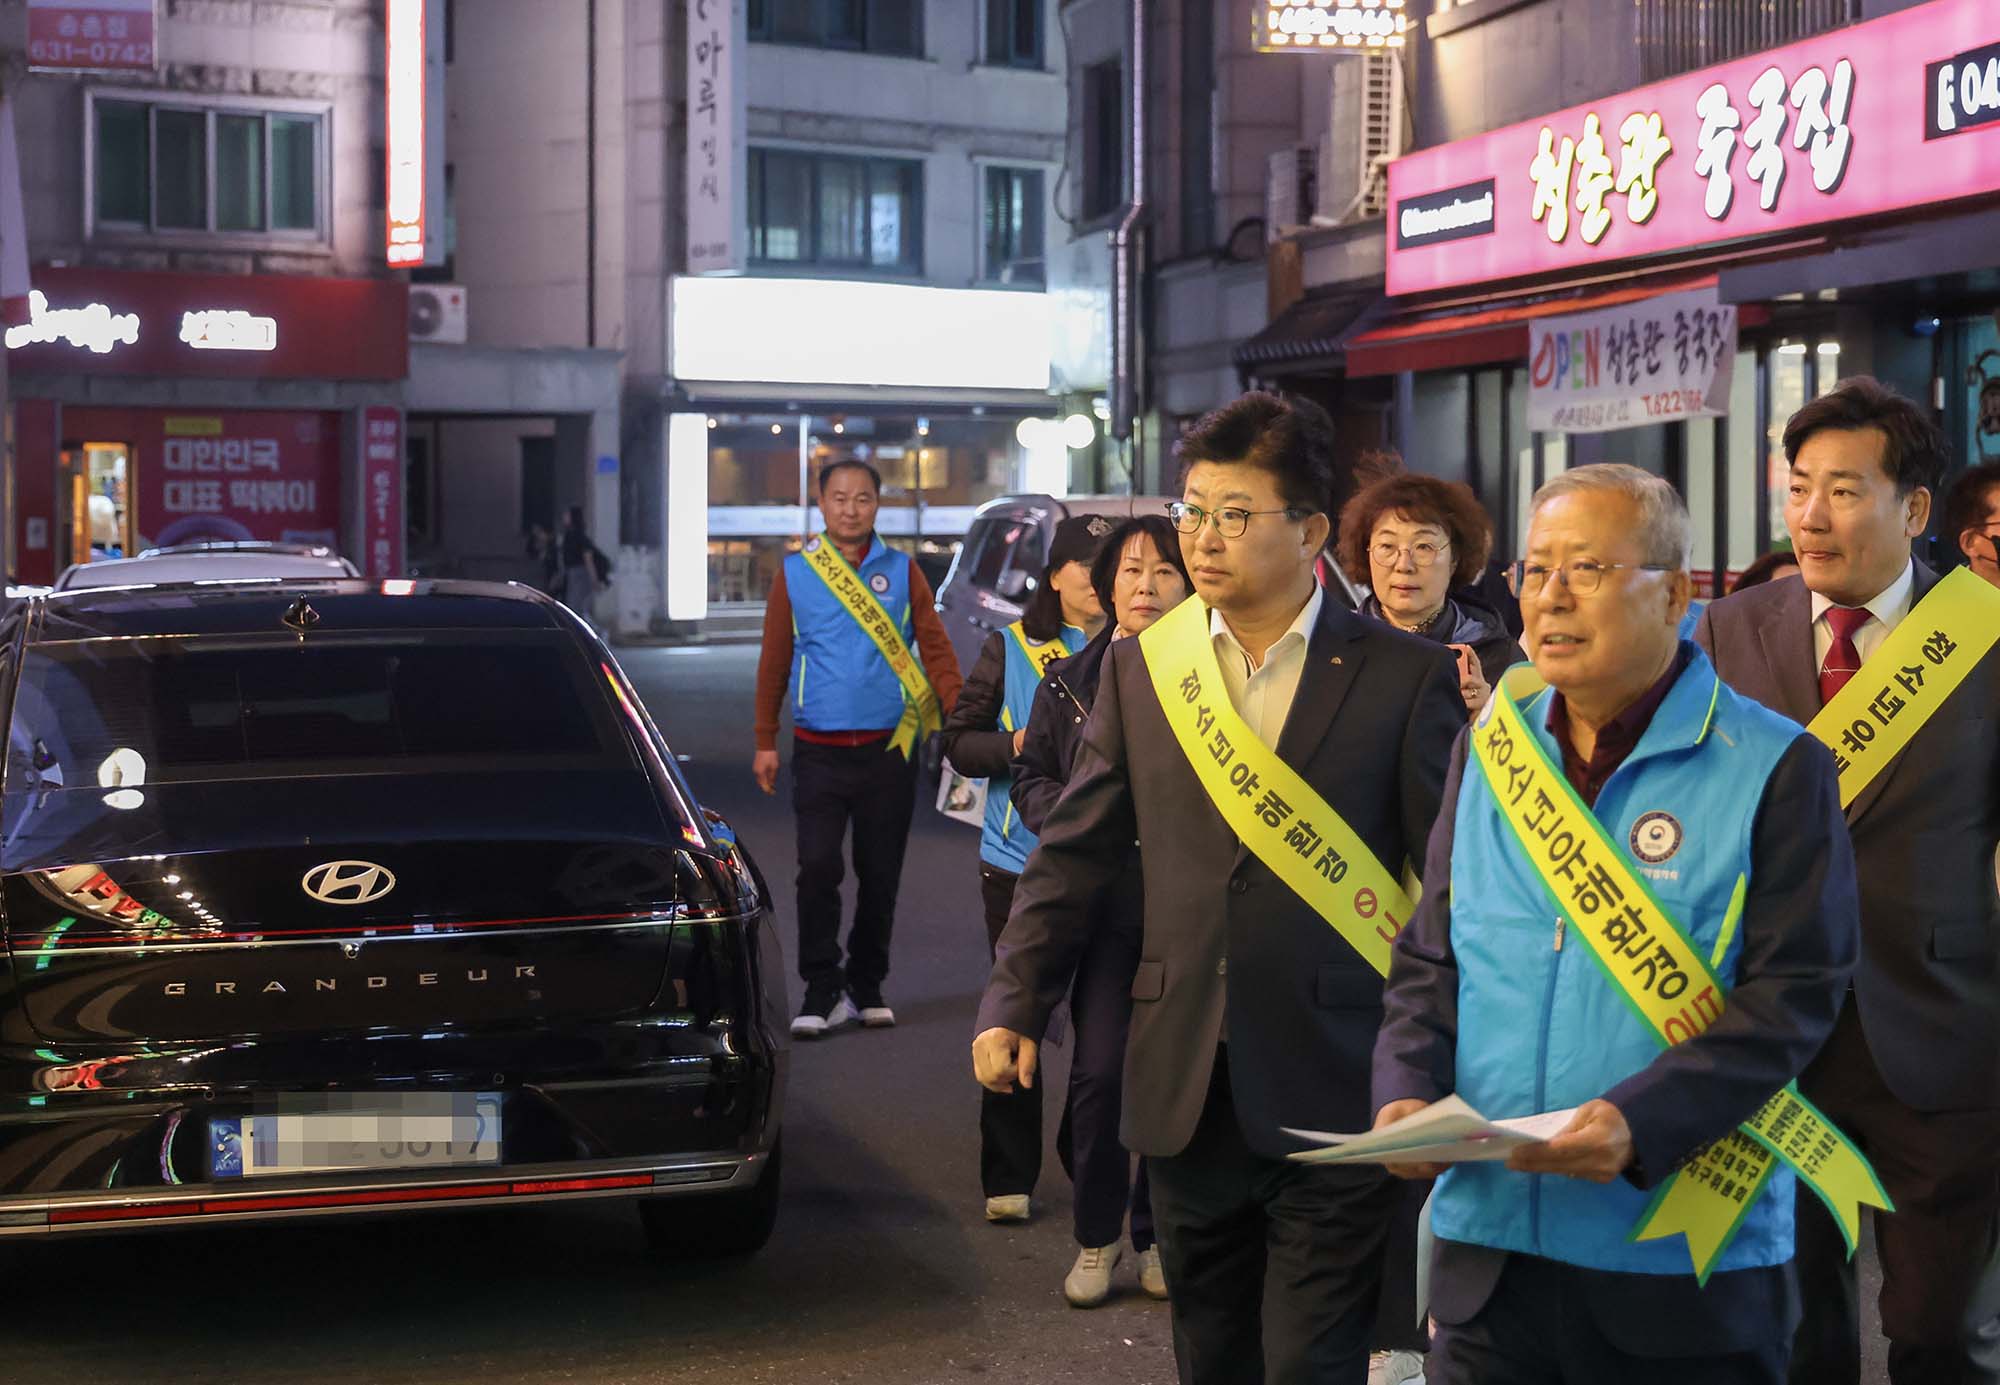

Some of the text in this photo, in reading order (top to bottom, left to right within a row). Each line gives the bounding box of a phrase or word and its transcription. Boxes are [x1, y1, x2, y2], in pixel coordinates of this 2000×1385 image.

[31, 40, 152, 63] 631-0742
[1960, 57, 2000, 116] 04
[1529, 57, 1855, 245] 청춘관 중국집
[1531, 326, 1601, 391] OPEN
[1605, 317, 1665, 386] 청춘관
[163, 439, 280, 472] 대한민국
[163, 480, 316, 512] 대표 떡볶이
[164, 964, 539, 996] GRANDEUR
